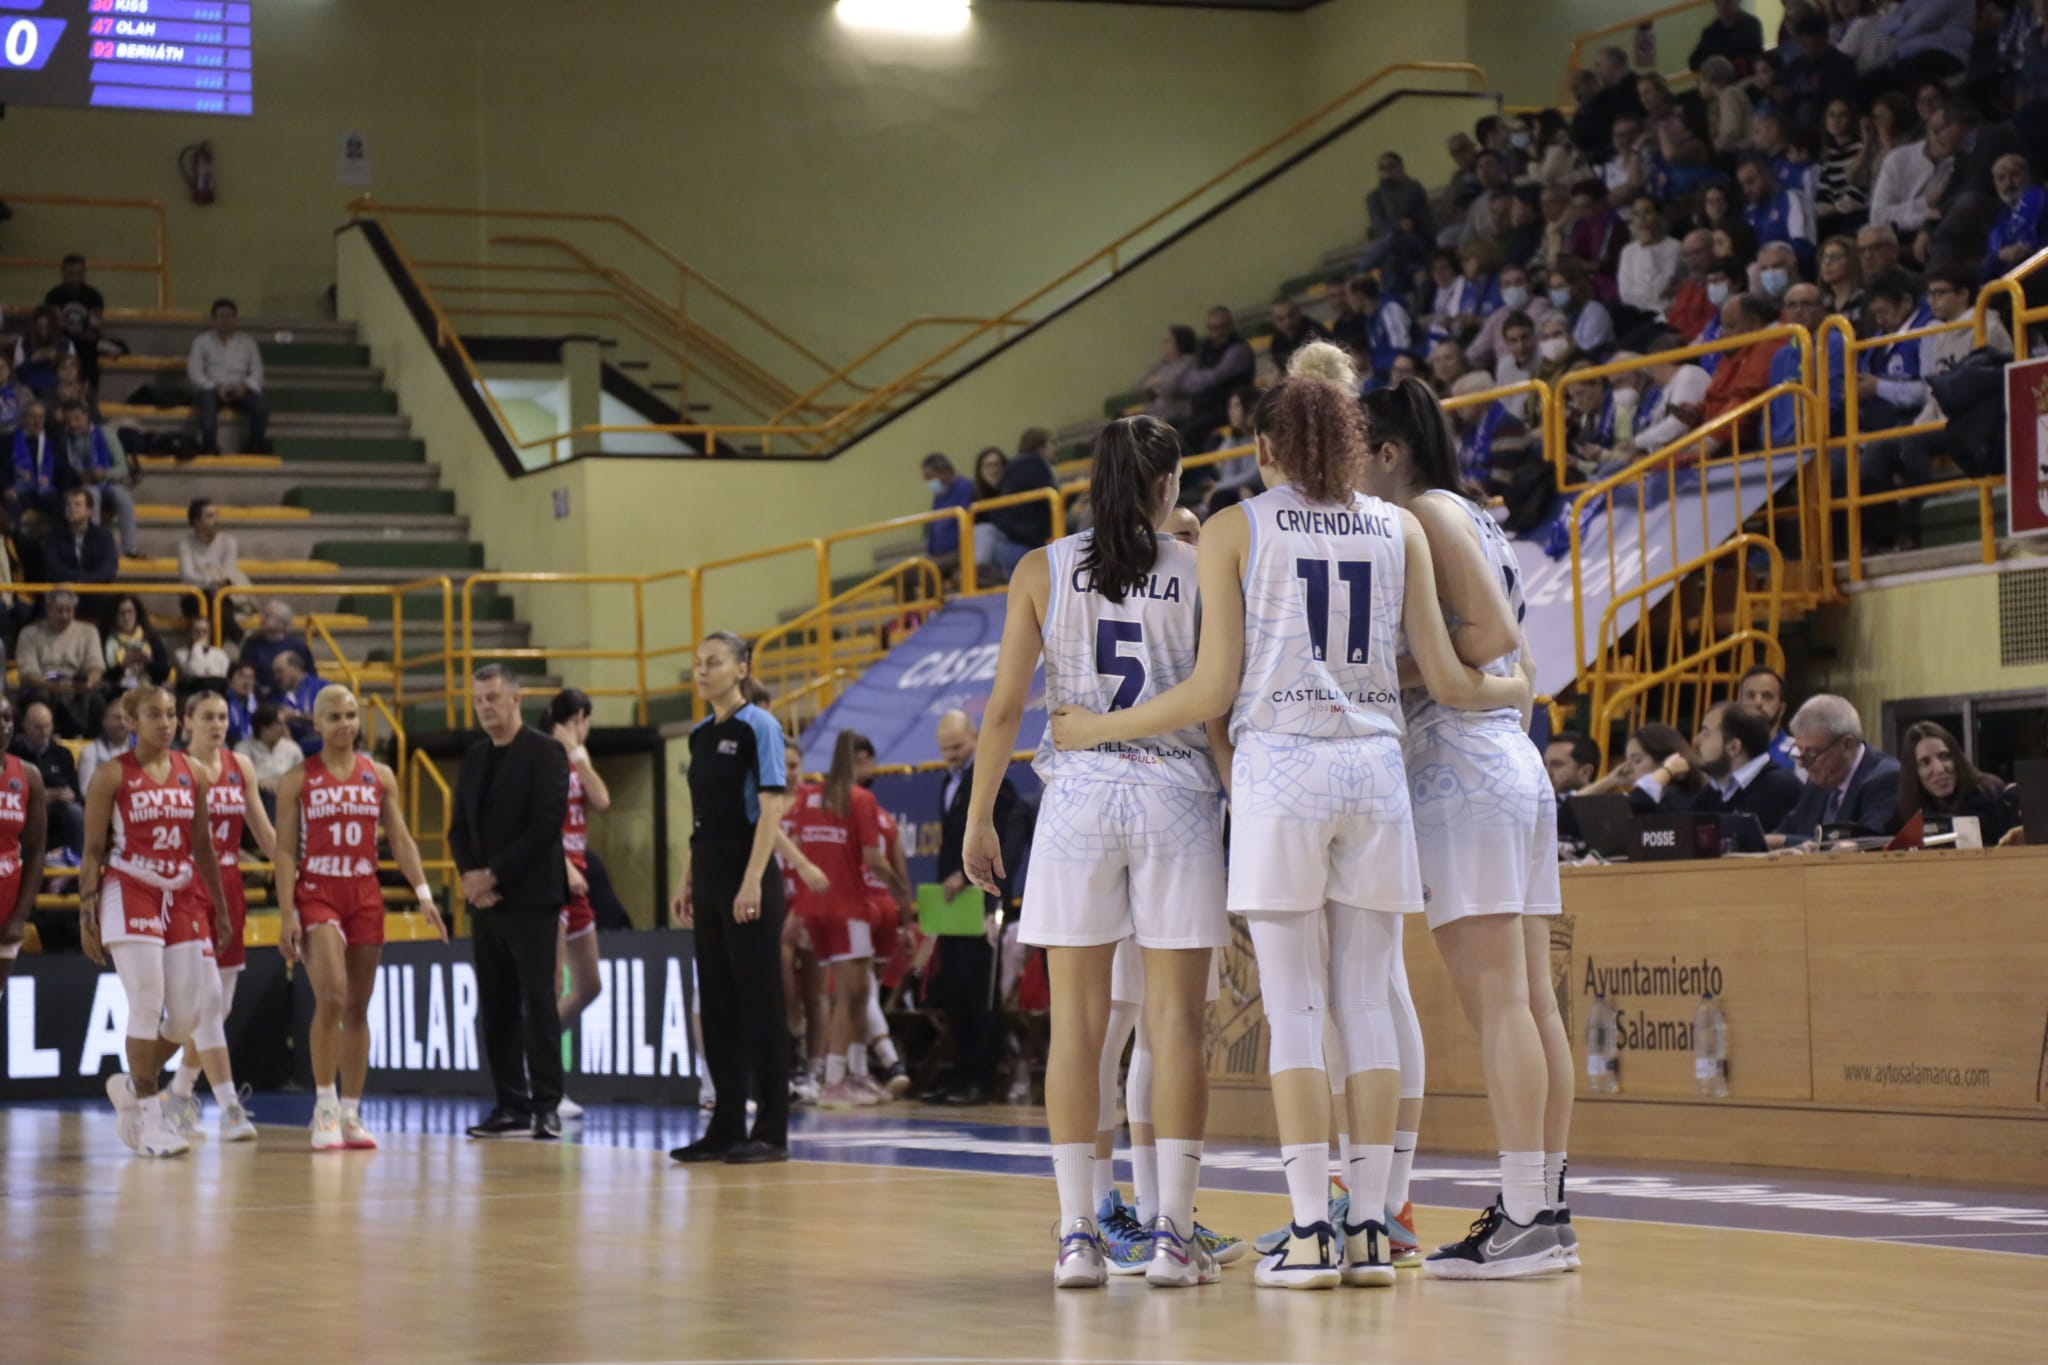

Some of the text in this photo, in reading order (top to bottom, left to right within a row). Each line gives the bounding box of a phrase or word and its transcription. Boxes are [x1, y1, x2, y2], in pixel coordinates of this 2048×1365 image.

[92, 18, 156, 37] 47 OLAH
[5, 19, 38, 66] 0
[1276, 509, 1393, 539] CRVENDAKIC
[1072, 567, 1180, 603] CAORLA
[1297, 558, 1371, 664] 11
[1096, 618, 1146, 713] 5
[1272, 689, 1343, 703] CASTILL
[1359, 688, 1397, 704] LEÓN
[130, 788, 193, 811] DVTK
[309, 785, 376, 806] DVTK
[129, 804, 195, 823] HUN-Therm
[307, 802, 380, 820] HUN-Therm
[152, 825, 181, 850] 24
[329, 821, 362, 847] 10
[1643, 830, 1676, 847] POSSE
[306, 856, 353, 878] HELL
[1584, 955, 1723, 997] Ayuntamiento
[580, 956, 703, 1078] MILA
[1615, 1009, 1695, 1051] Salama
[1843, 1061, 1991, 1088] www.aytosalamanca.com
